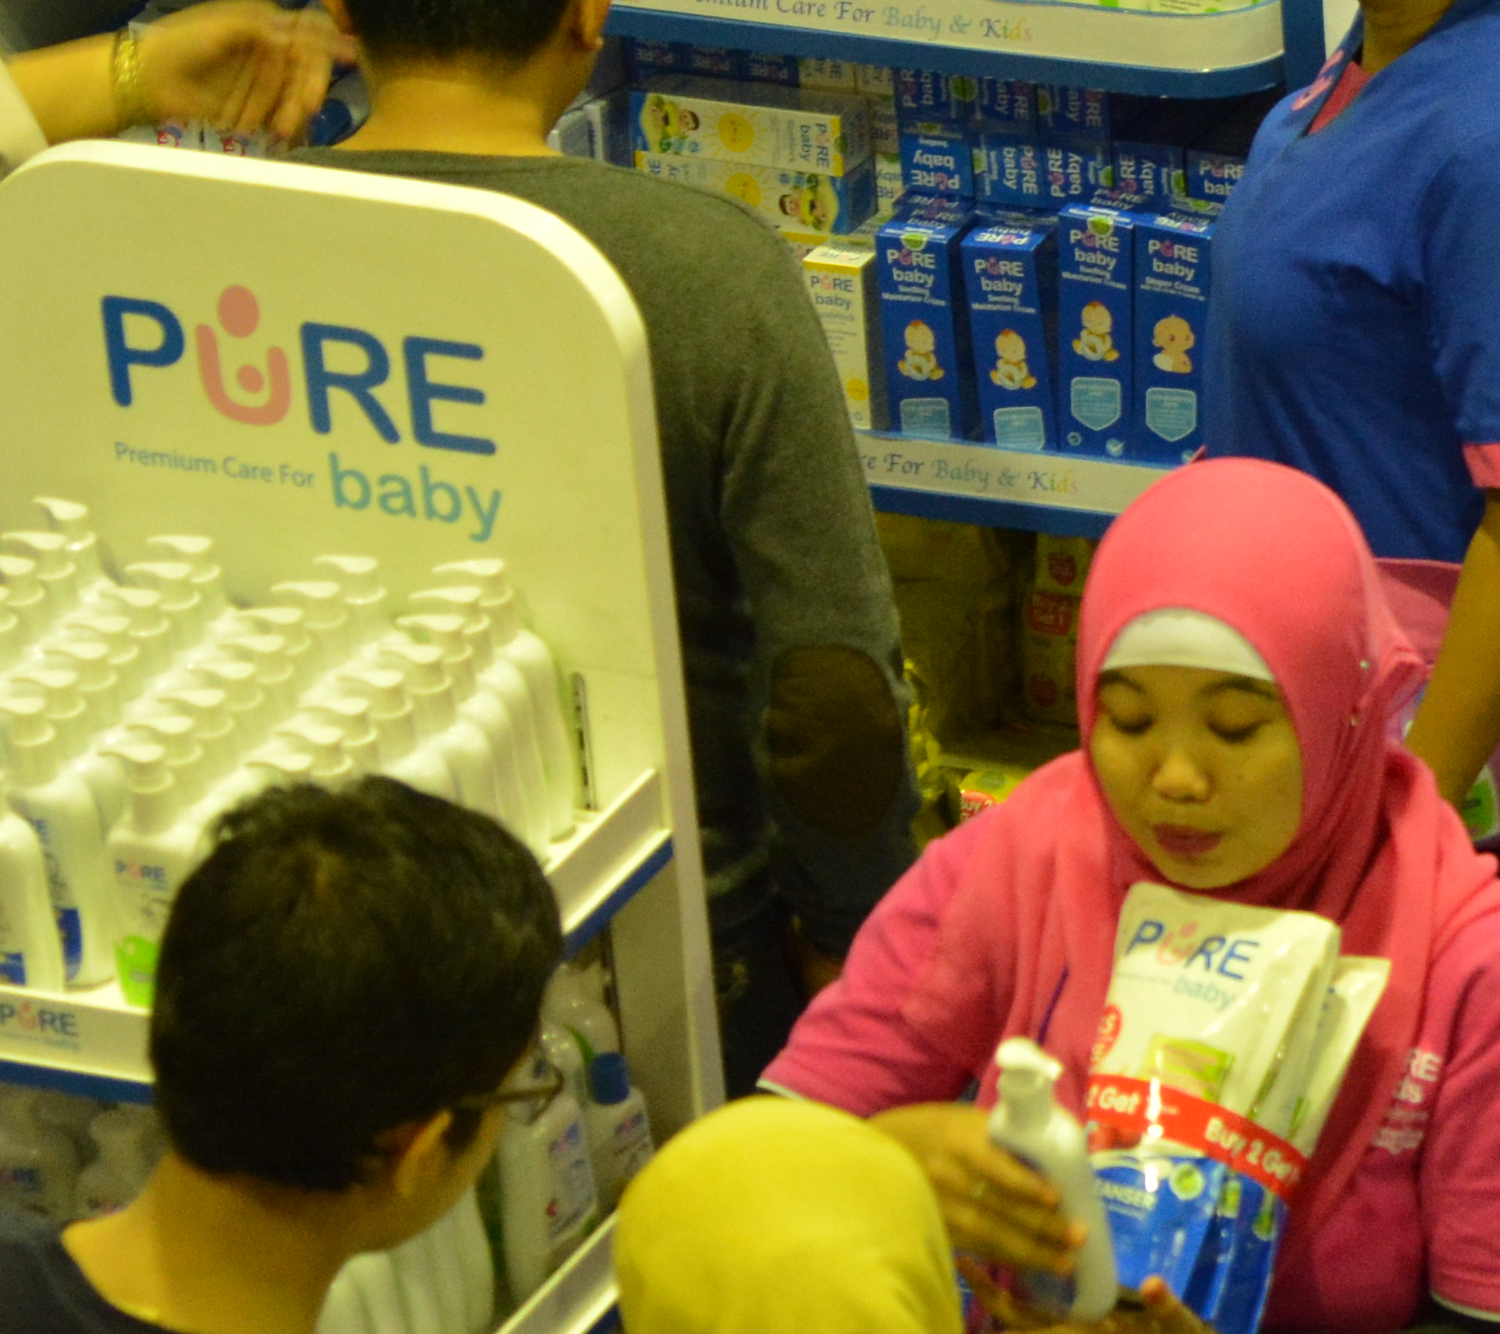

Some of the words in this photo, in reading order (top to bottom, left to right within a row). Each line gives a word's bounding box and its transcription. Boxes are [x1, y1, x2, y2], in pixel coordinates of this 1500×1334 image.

[834, 2, 875, 24] For
[882, 5, 942, 40] Baby
[949, 19, 971, 35] &
[979, 17, 1033, 42] Kids
[1074, 248, 1117, 270] baby
[1152, 256, 1195, 281] baby
[893, 267, 935, 288] baby
[981, 276, 1023, 295] baby
[100, 284, 497, 458] PURE
[114, 440, 217, 474] Premium
[221, 452, 274, 484] Care
[279, 462, 317, 491] For
[328, 451, 503, 544] baby
[1124, 920, 1260, 982] PURE
[1099, 1088, 1139, 1113] Get
[1205, 1117, 1246, 1155] Buy
